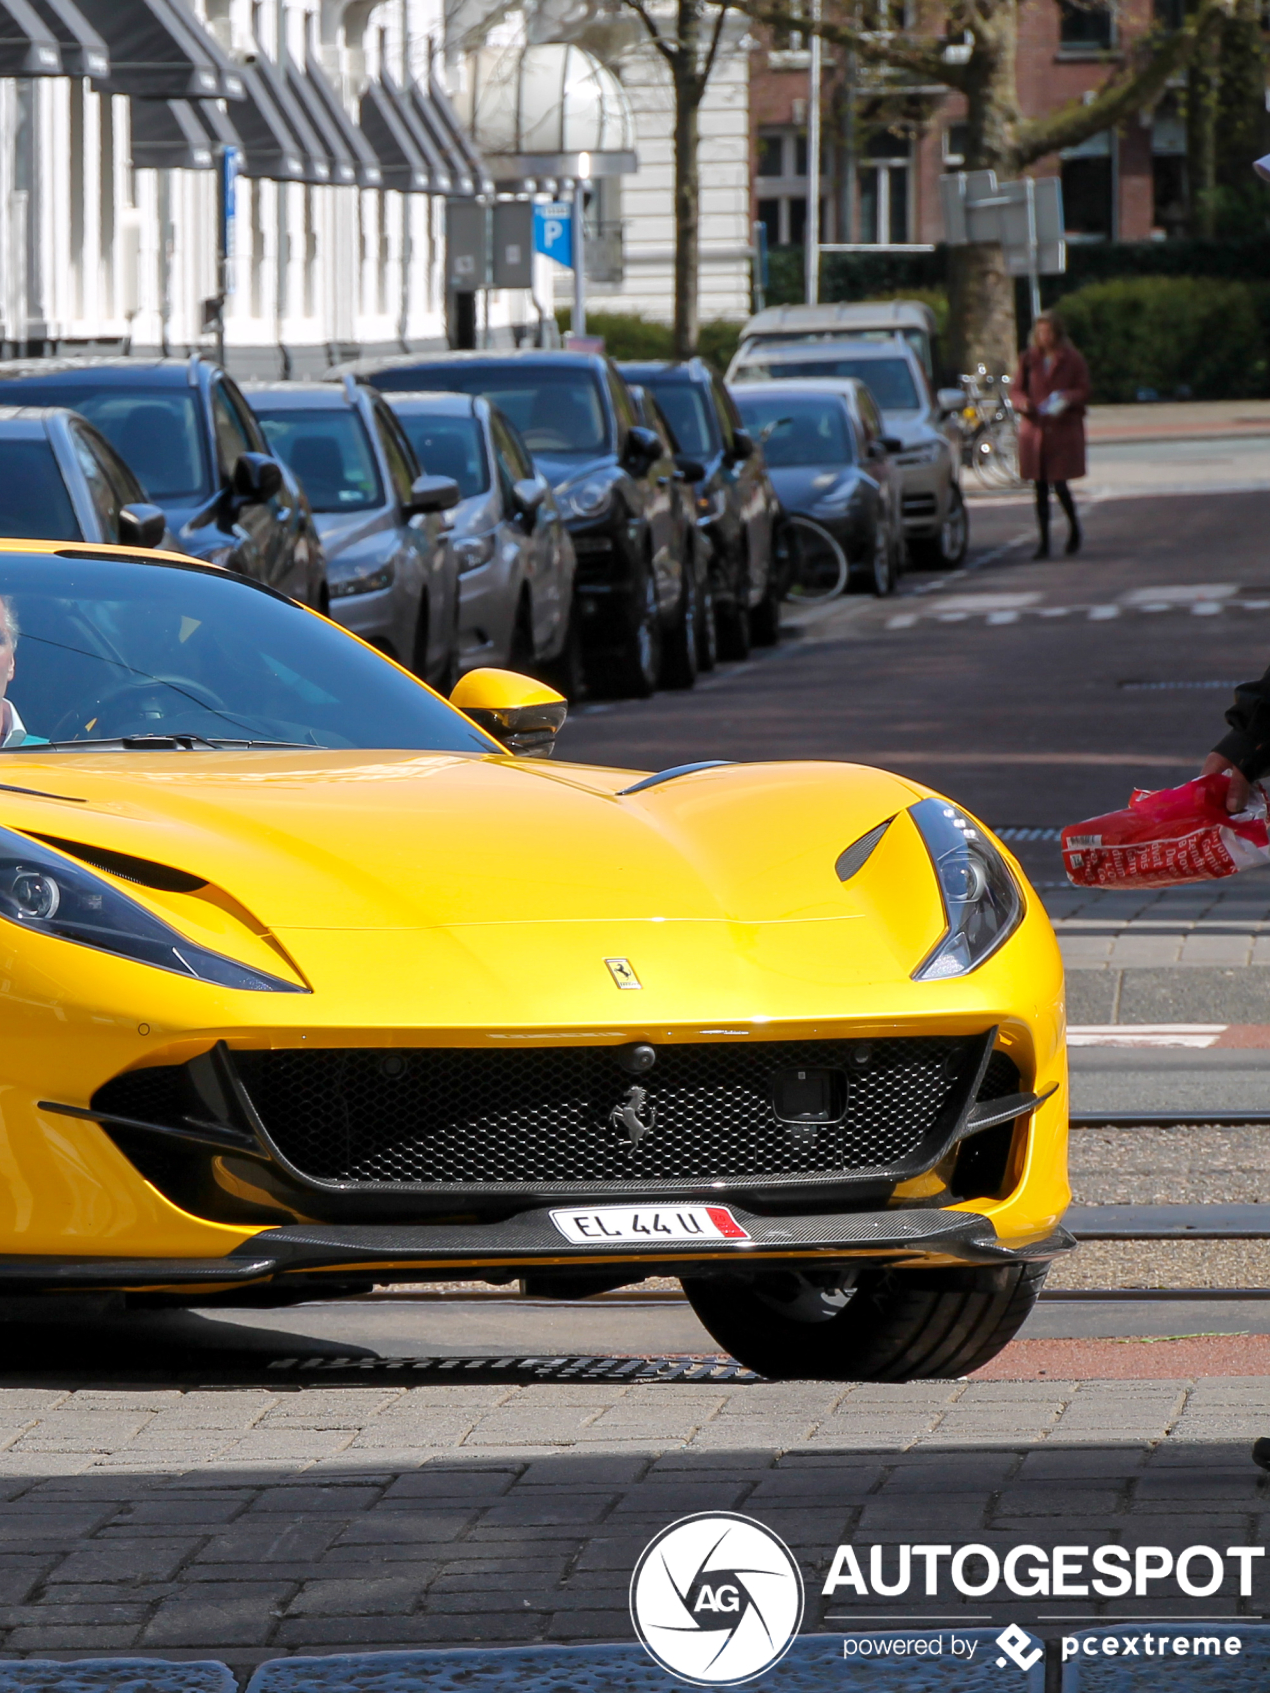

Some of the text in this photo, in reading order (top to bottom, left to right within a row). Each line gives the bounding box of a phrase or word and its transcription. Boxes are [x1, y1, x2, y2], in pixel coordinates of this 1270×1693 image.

[544, 220, 563, 249] P
[1112, 849, 1126, 877] dium
[1151, 842, 1163, 868] dvat
[573, 1213, 704, 1237] EL 44 U
